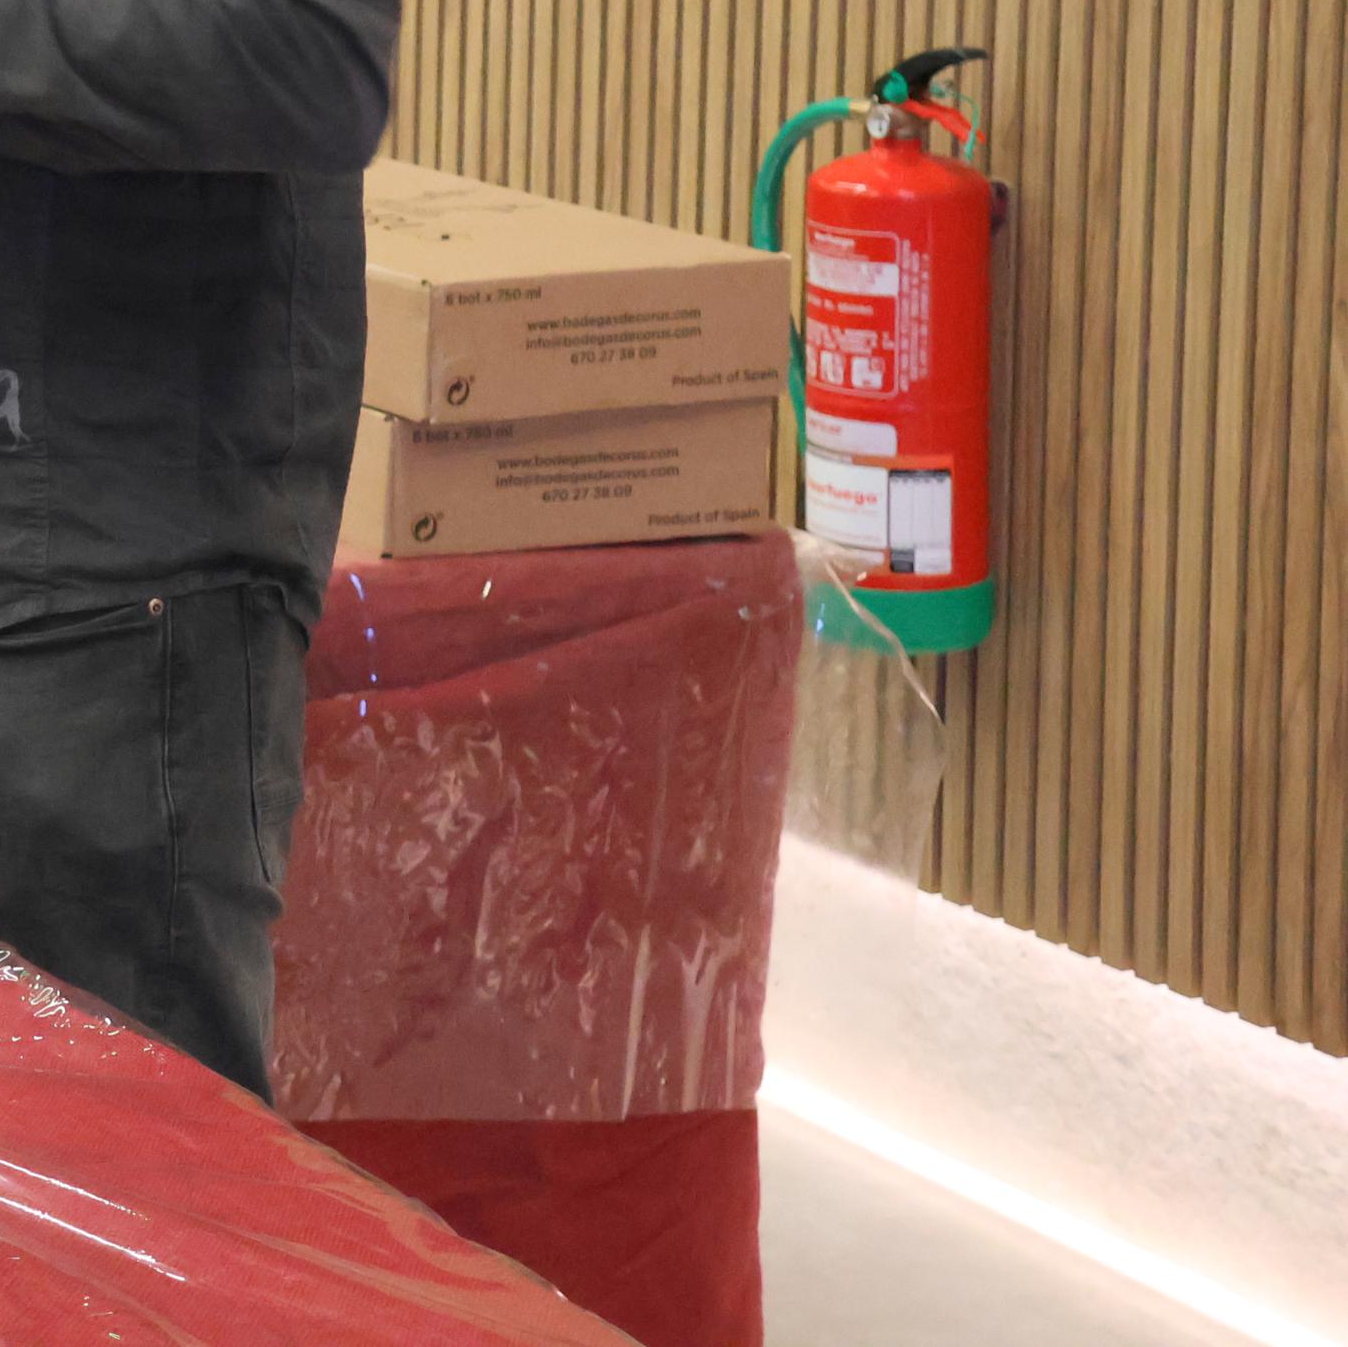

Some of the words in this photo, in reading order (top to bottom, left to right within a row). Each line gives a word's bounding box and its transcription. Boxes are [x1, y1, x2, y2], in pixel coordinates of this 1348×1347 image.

[570, 351, 596, 366] 670
[599, 349, 615, 364] 27
[671, 371, 722, 388] Product
[726, 369, 741, 383] of
[541, 487, 569, 504] 670
[572, 486, 590, 501] 27
[592, 485, 610, 500] 38
[647, 510, 701, 527] Product
[705, 509, 720, 524] of
[723, 507, 761, 523] Spain
